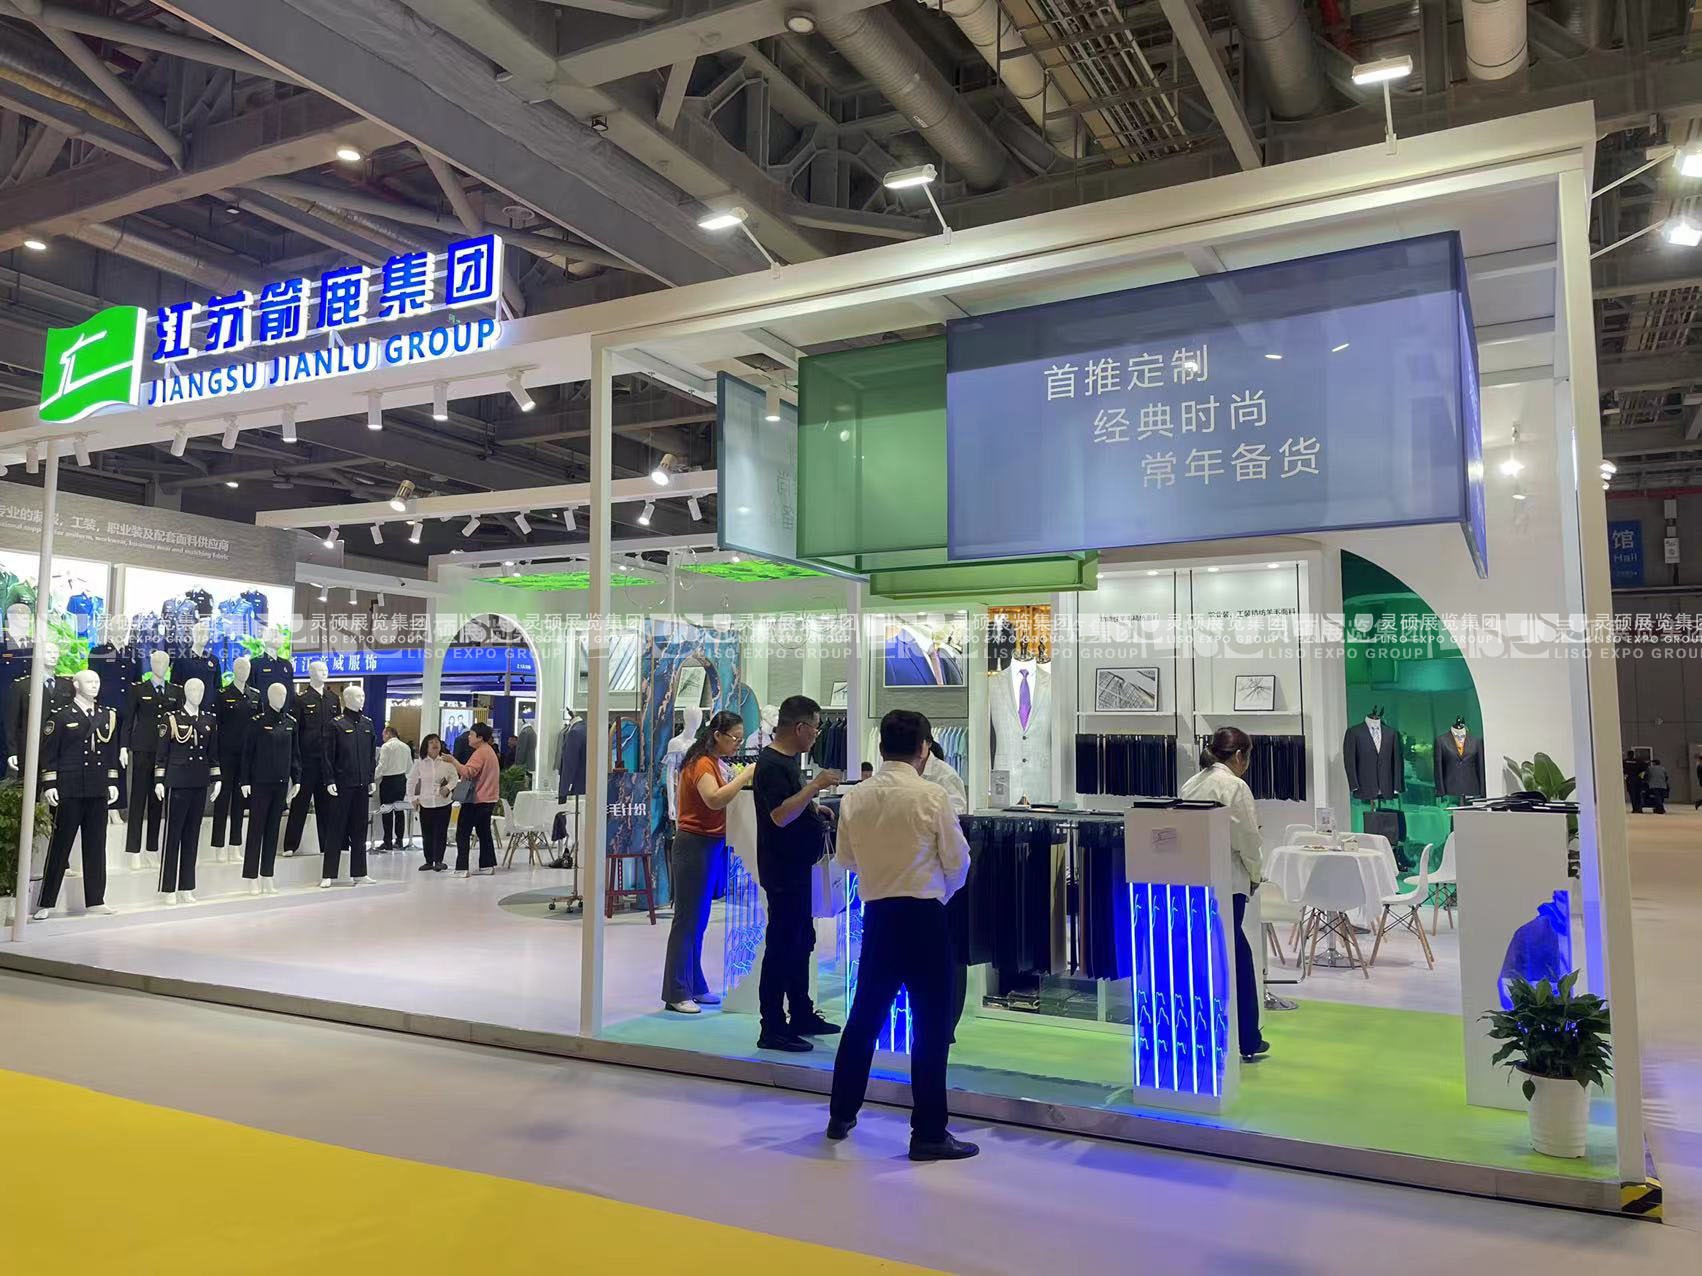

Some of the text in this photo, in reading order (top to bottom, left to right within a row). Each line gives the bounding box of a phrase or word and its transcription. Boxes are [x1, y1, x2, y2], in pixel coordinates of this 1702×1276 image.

[152, 234, 498, 362] 江苏箭鹿集团
[148, 318, 496, 406] JIANGSU JIANLU GROUP
[1043, 344, 1209, 401] 首推定制
[1093, 390, 1268, 443] 经典时尚
[1141, 436, 1322, 489] 常年备货
[1612, 530, 1635, 549] 馆
[606, 803, 646, 817] 毛针织
